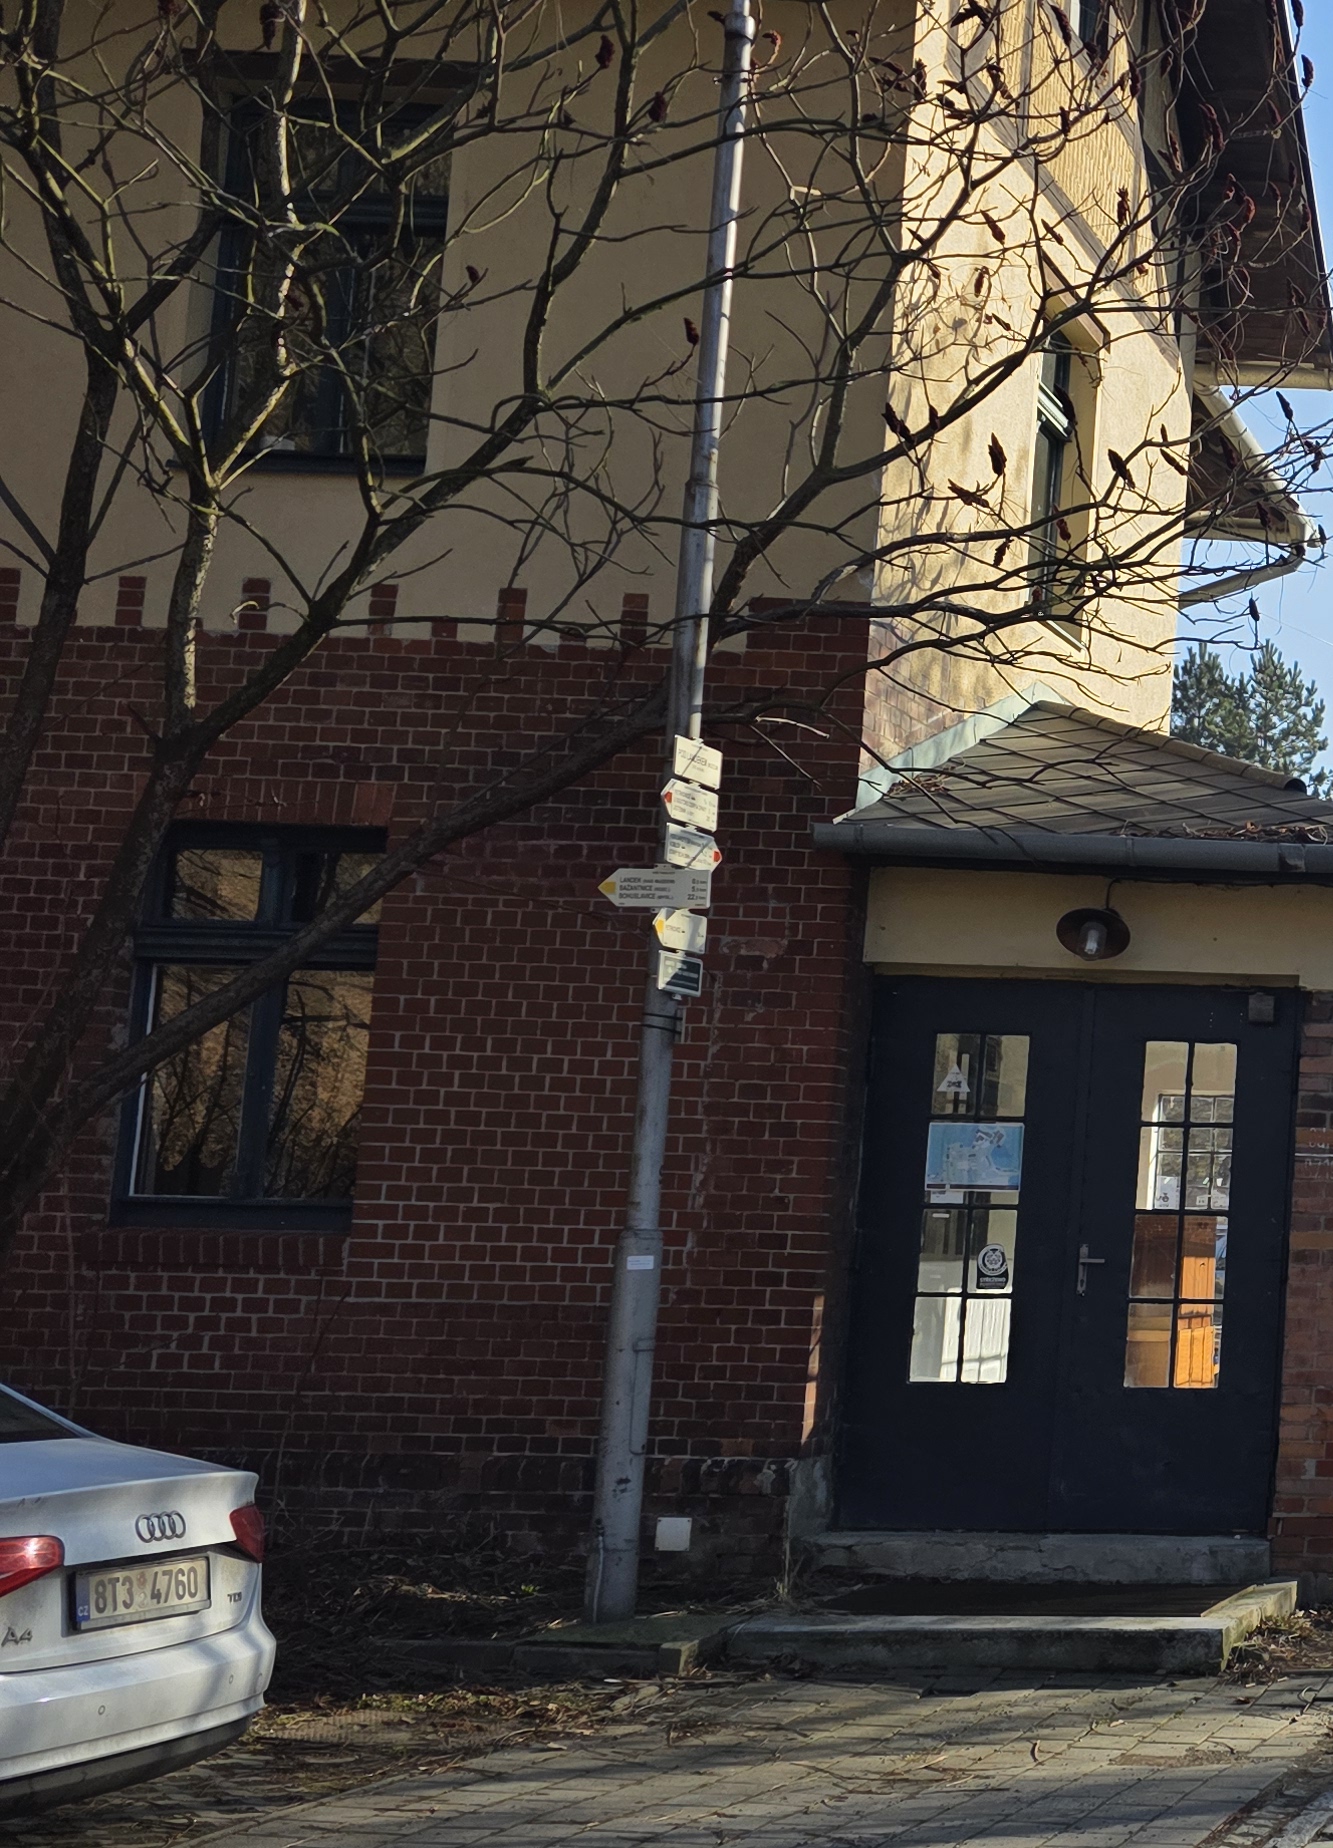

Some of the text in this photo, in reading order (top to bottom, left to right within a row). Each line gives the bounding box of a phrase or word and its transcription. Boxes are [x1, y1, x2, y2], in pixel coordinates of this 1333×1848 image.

[94, 1566, 199, 1614] 8T3 4760
[77, 1604, 89, 1617] CZ
[1, 1626, 33, 1647] A4
